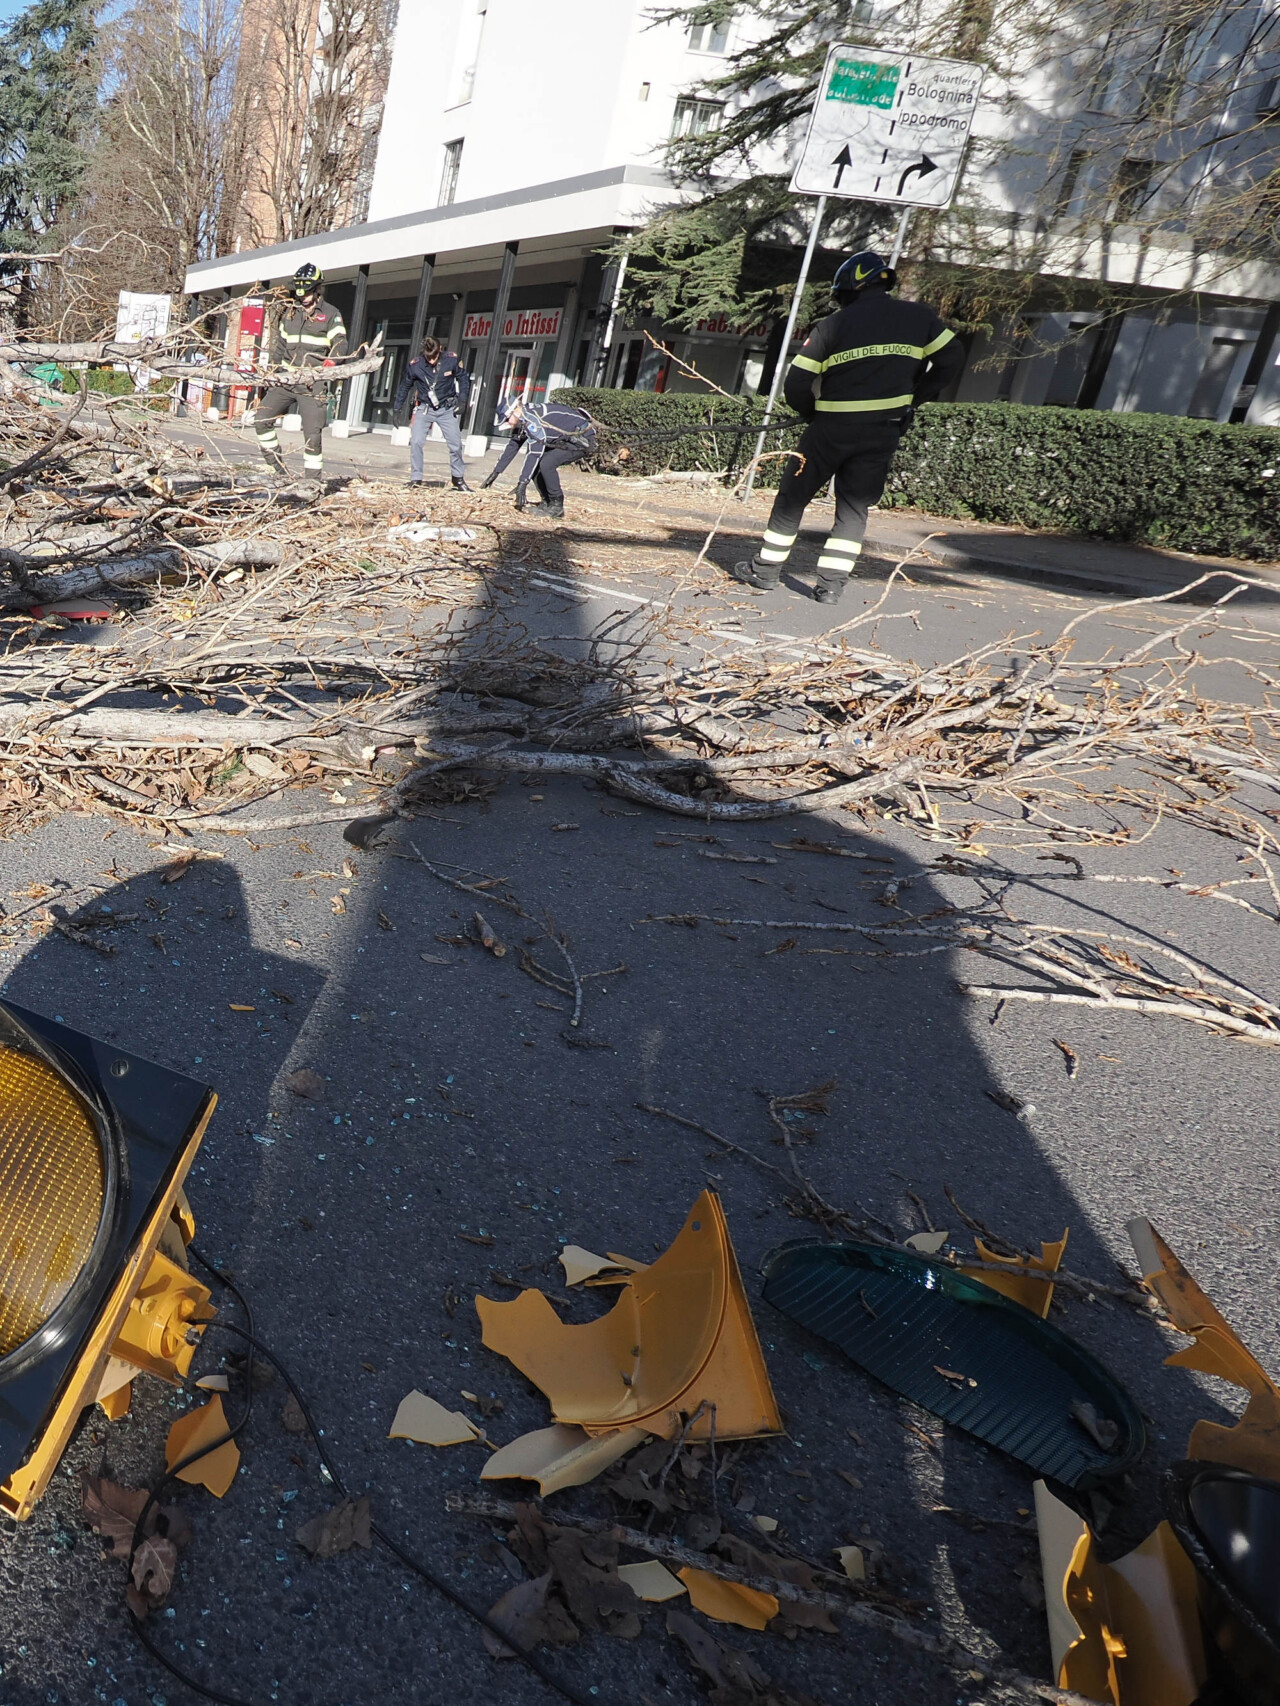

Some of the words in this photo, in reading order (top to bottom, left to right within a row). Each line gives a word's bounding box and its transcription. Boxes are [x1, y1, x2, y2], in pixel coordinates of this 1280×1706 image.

[907, 82, 974, 104] Bolognina
[898, 109, 968, 131] ippodromo
[464, 315, 513, 337] Fabro
[515, 310, 560, 336] Infissi
[833, 349, 860, 363] VIGILI
[862, 346, 880, 356] DEL
[882, 344, 912, 355] FUOCO
